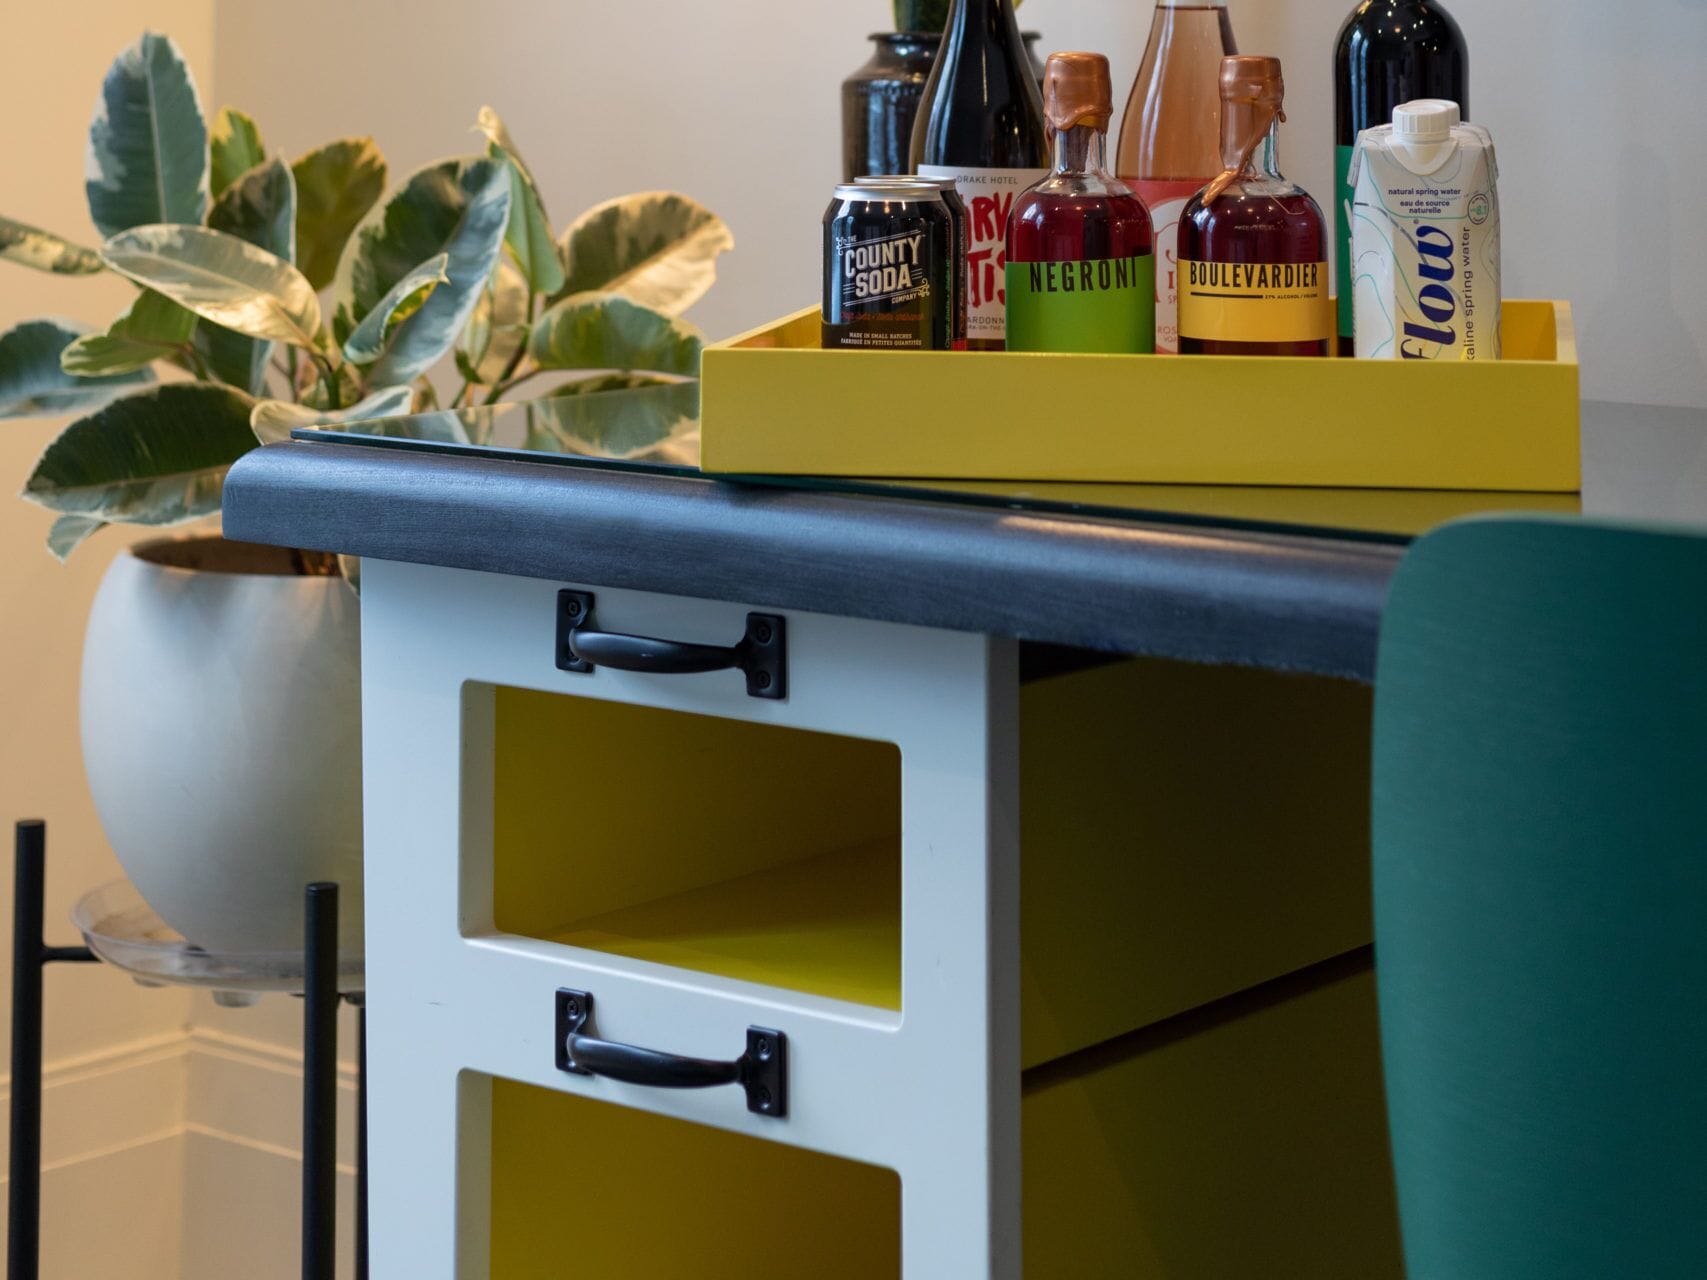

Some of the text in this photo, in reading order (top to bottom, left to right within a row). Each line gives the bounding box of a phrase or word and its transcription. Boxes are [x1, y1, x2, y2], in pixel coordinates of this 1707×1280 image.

[957, 175, 1019, 185] DRAKE HOTEL
[1388, 188, 1414, 196] natural
[1416, 188, 1439, 197] spring
[847, 234, 857, 242] THE
[1461, 227, 1471, 267] water
[844, 234, 922, 279] COUNTY
[855, 263, 913, 298] SODA
[1029, 257, 1137, 293] NEGRONI
[1190, 261, 1318, 289] BOULEVARDIER
[1400, 225, 1456, 359] flow
[891, 293, 918, 304] COMPANY
[1462, 269, 1475, 317] spring
